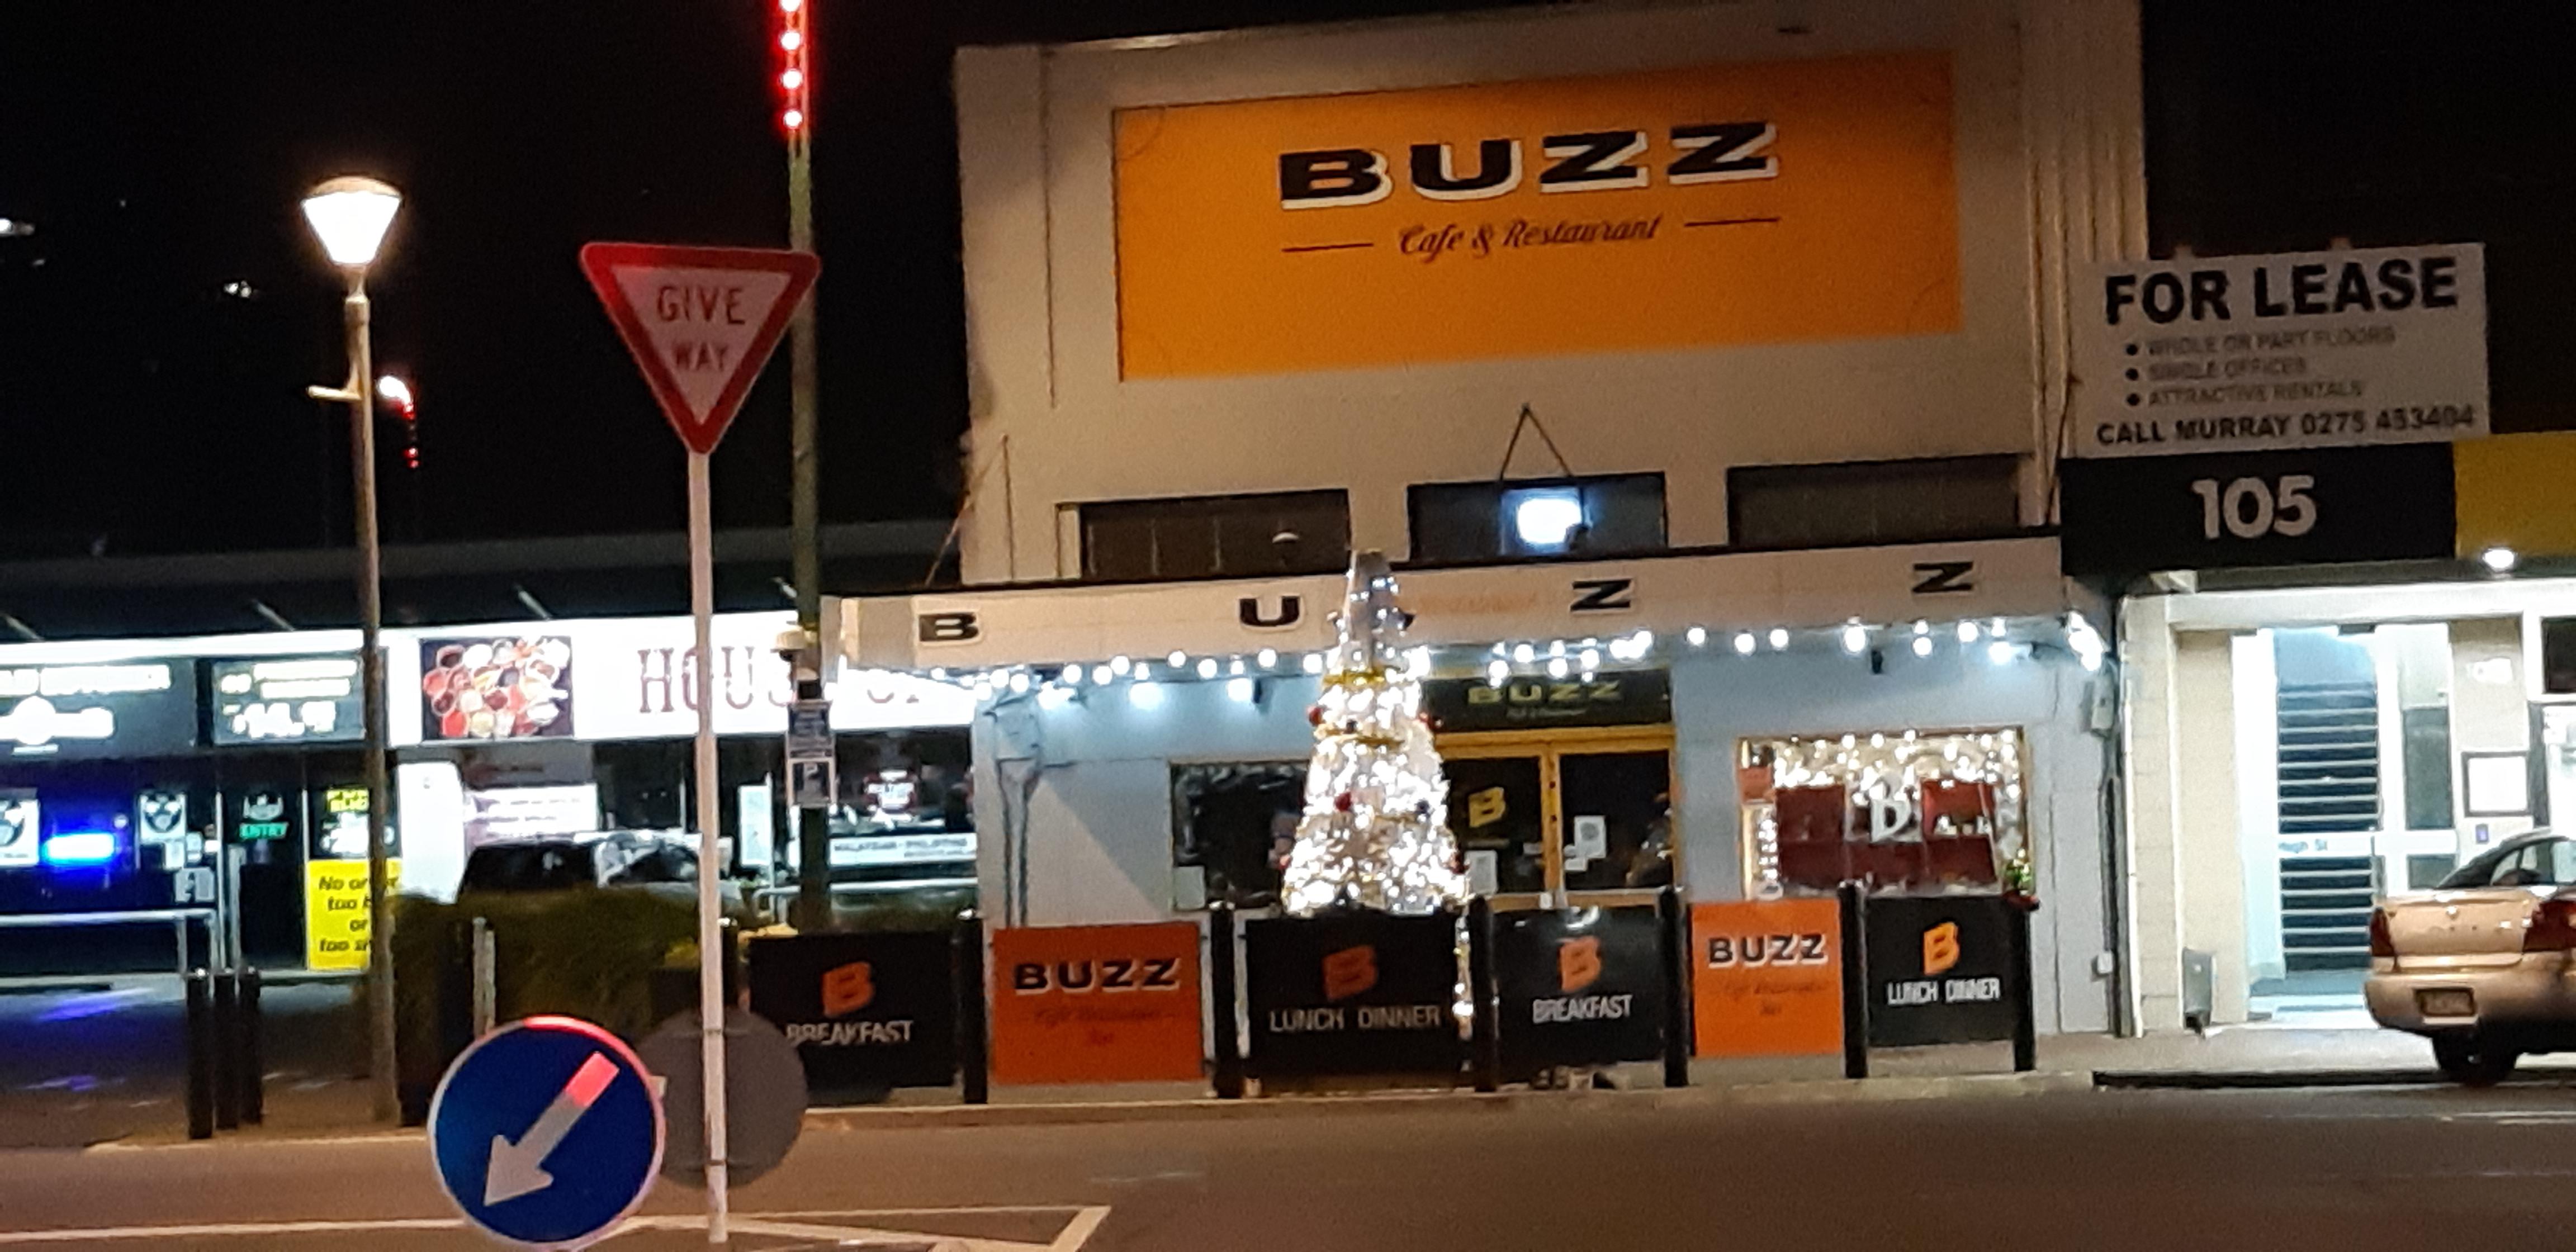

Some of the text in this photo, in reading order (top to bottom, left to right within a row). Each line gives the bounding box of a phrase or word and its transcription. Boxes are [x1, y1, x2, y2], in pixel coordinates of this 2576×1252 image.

[1278, 121, 1780, 211] BUZZ
[1471, 223, 1493, 259] &
[1503, 212, 1664, 248] Restaurant
[657, 286, 746, 325] GIVE
[2105, 257, 2457, 325] FOR LEASE
[674, 343, 728, 371] WAY
[2148, 325, 2397, 356] WHOLE OR PART FLOORS
[2149, 356, 2306, 381] SINGLE OFFICES
[2148, 380, 2364, 407] ATTRACTIVE RENTALS
[2096, 421, 2166, 445] CALL
[2176, 415, 2290, 441] MURRAY
[2301, 409, 2365, 435] 0275
[2191, 475, 2317, 540] 105
[920, 613, 979, 642] B
[1239, 596, 1300, 627] U
[1569, 577, 1632, 612] Z
[1911, 561, 1974, 595] Z
[637, 645, 798, 713] HOU
[1468, 680, 1621, 704] BUZZ
[1469, 786, 1505, 828] B
[318, 875, 344, 890] No
[327, 897, 357, 911] too
[319, 937, 349, 952] too
[1708, 932, 1829, 969] BUZZ
[1923, 921, 1961, 975] B
[1015, 957, 1181, 996] BUZZ
[1323, 945, 1379, 1001] B
[1560, 935, 1602, 994] B
[822, 961, 874, 1017] B
[1887, 977, 2000, 1006] LUNCH DINNER
[1270, 1006, 1440, 1032] LUNCH DINNER
[1532, 994, 1633, 1025] BREAKFAST
[786, 1019, 913, 1046] BREAKFAST
